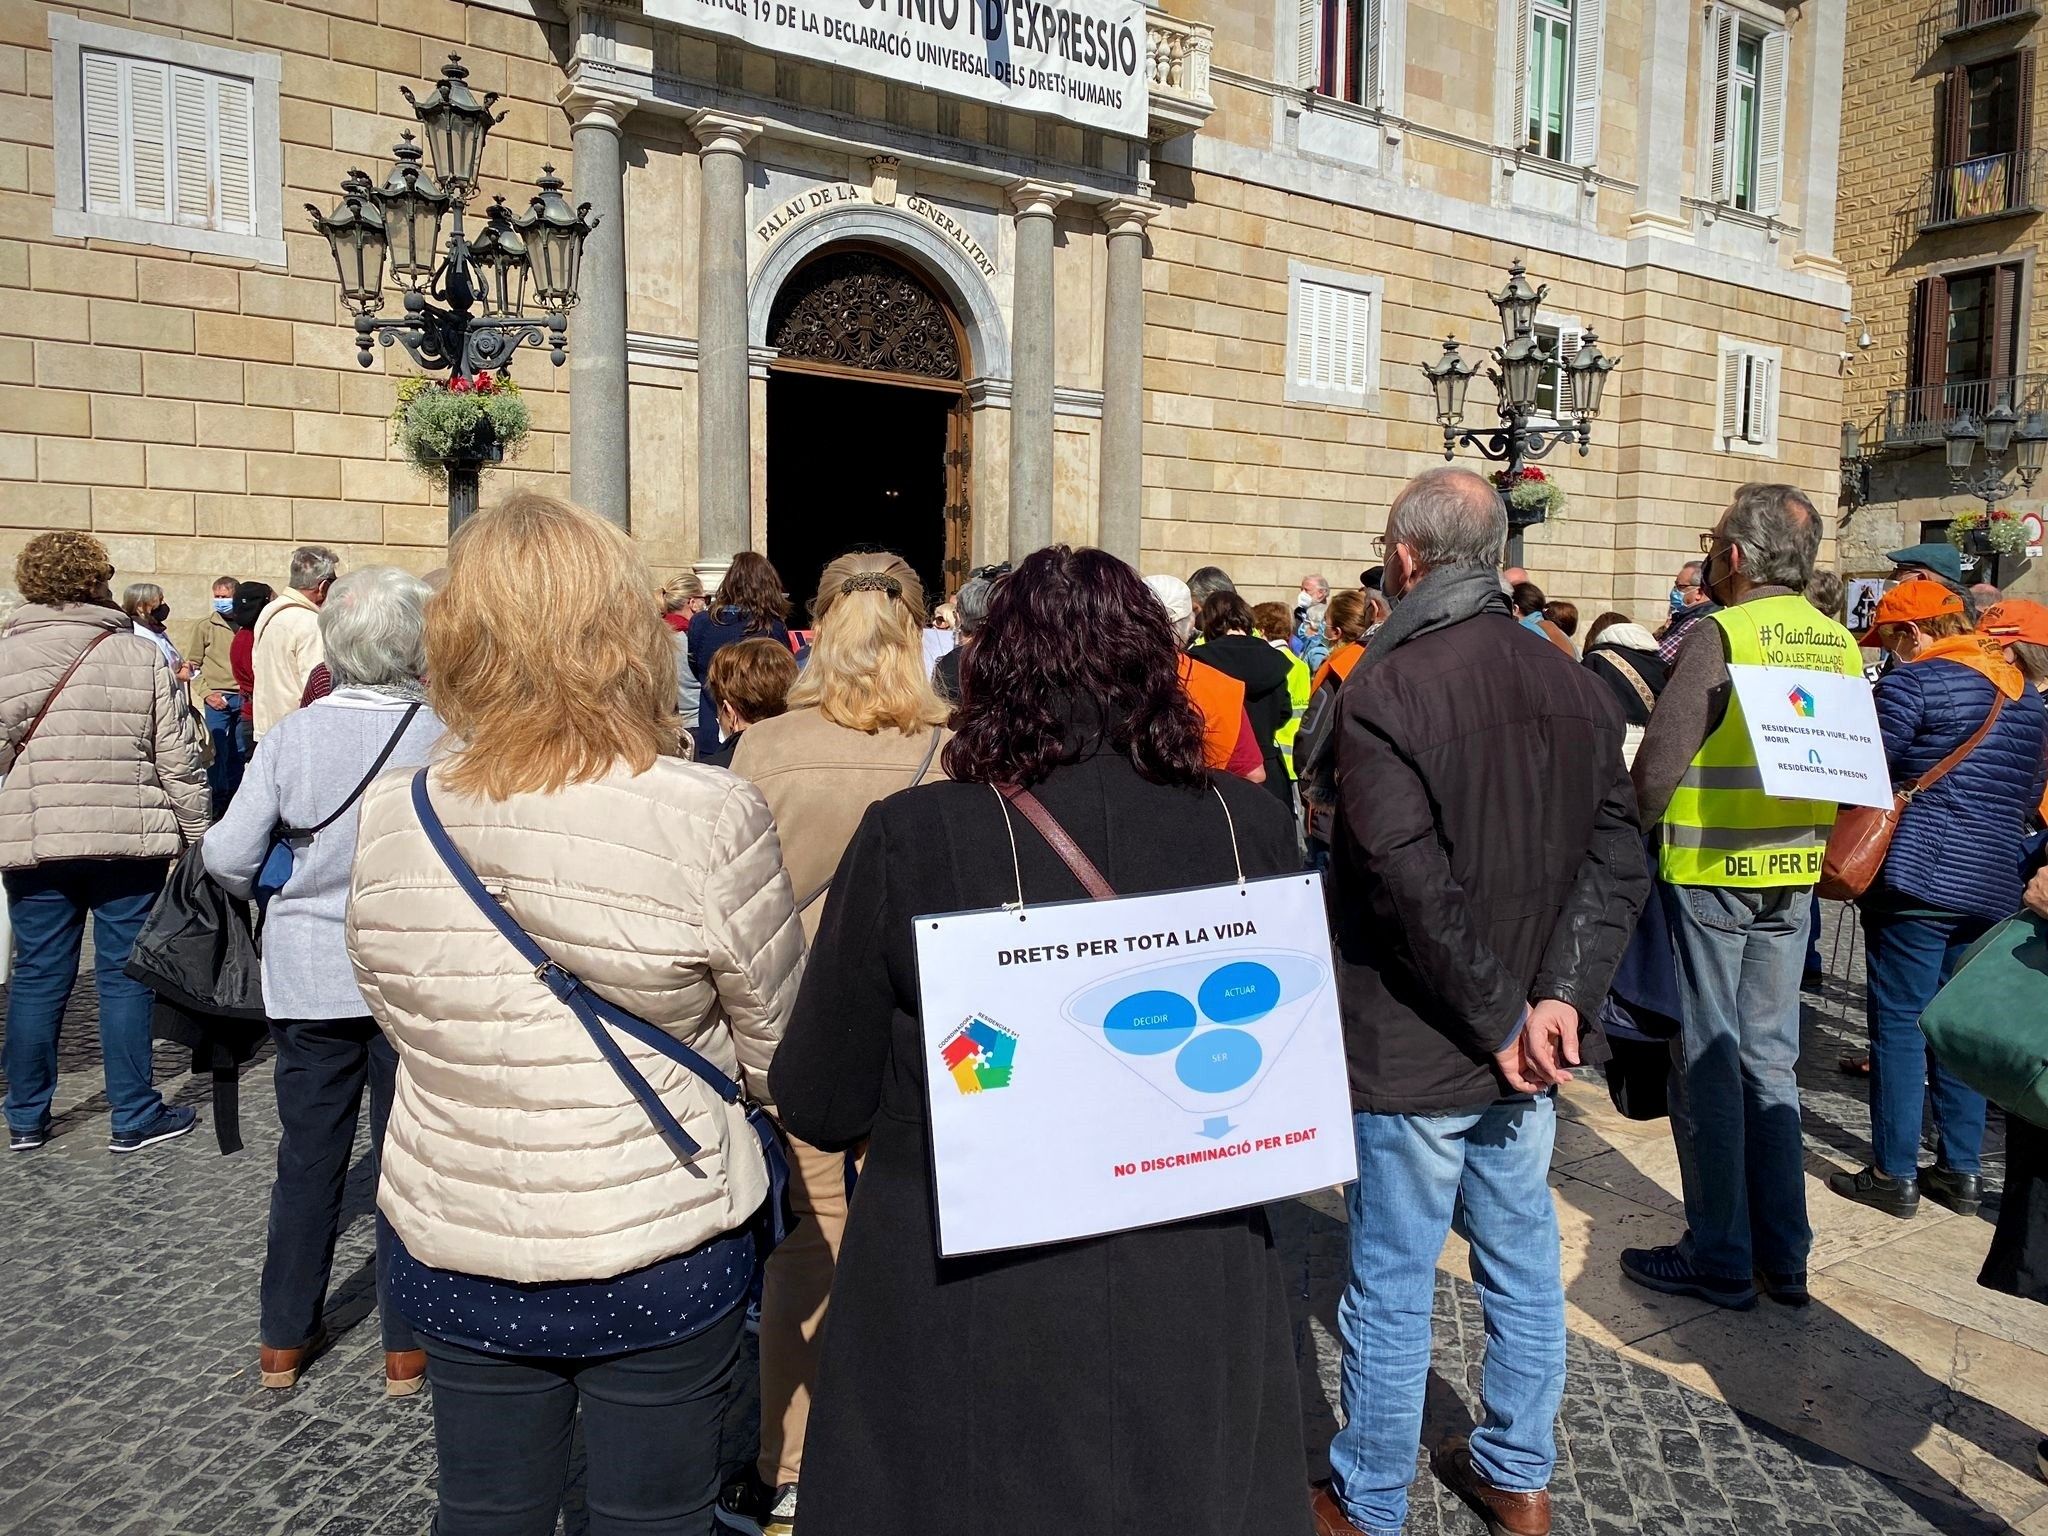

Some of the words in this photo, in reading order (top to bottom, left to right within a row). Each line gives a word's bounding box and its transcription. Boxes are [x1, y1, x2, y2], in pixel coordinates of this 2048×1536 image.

[984, 0, 1137, 77] D'EXPRESSIÓ
[753, 0, 771, 22] 19
[776, 4, 796, 29] DE
[801, 9, 820, 35] LA
[823, 16, 912, 59] DECLARACIÓ
[916, 40, 991, 79] UNIVERSAL
[994, 60, 1026, 87] DELS
[1028, 68, 1067, 96] DRETS
[1068, 77, 1123, 110] HUMANS
[757, 198, 807, 242] PALAU
[811, 188, 833, 208] DE
[838, 184, 860, 201] LA
[906, 196, 996, 278] GENERALITAT
[1767, 650, 1783, 663] NO
[1785, 653, 1791, 663] A
[1792, 653, 1805, 663] LES
[1764, 735, 1790, 744] MORIR
[1811, 729, 1825, 737] PER
[1849, 734, 1858, 742] NO
[1859, 736, 1872, 744] PER
[1828, 767, 1837, 775] NO
[1839, 769, 1868, 780] PRESONS
[1725, 855, 1757, 877] DEL
[1769, 853, 1803, 874] PER
[998, 944, 1070, 966] DRETS
[1076, 939, 1119, 958] PER
[1124, 931, 1180, 952] TOTA
[1185, 927, 1210, 945] LA
[1214, 920, 1257, 940] VIDA
[1224, 984, 1256, 998] ACTUAR
[1133, 1014, 1169, 1027] DECIDIR
[938, 1014, 973, 1048] COORDINADORA
[1211, 1052, 1228, 1063] SER
[1114, 1163, 1136, 1177] NO
[1141, 1140, 1251, 1172] DISCRIMINACIÓ
[1255, 1136, 1281, 1152] PER
[1285, 1128, 1317, 1145] EDAT
